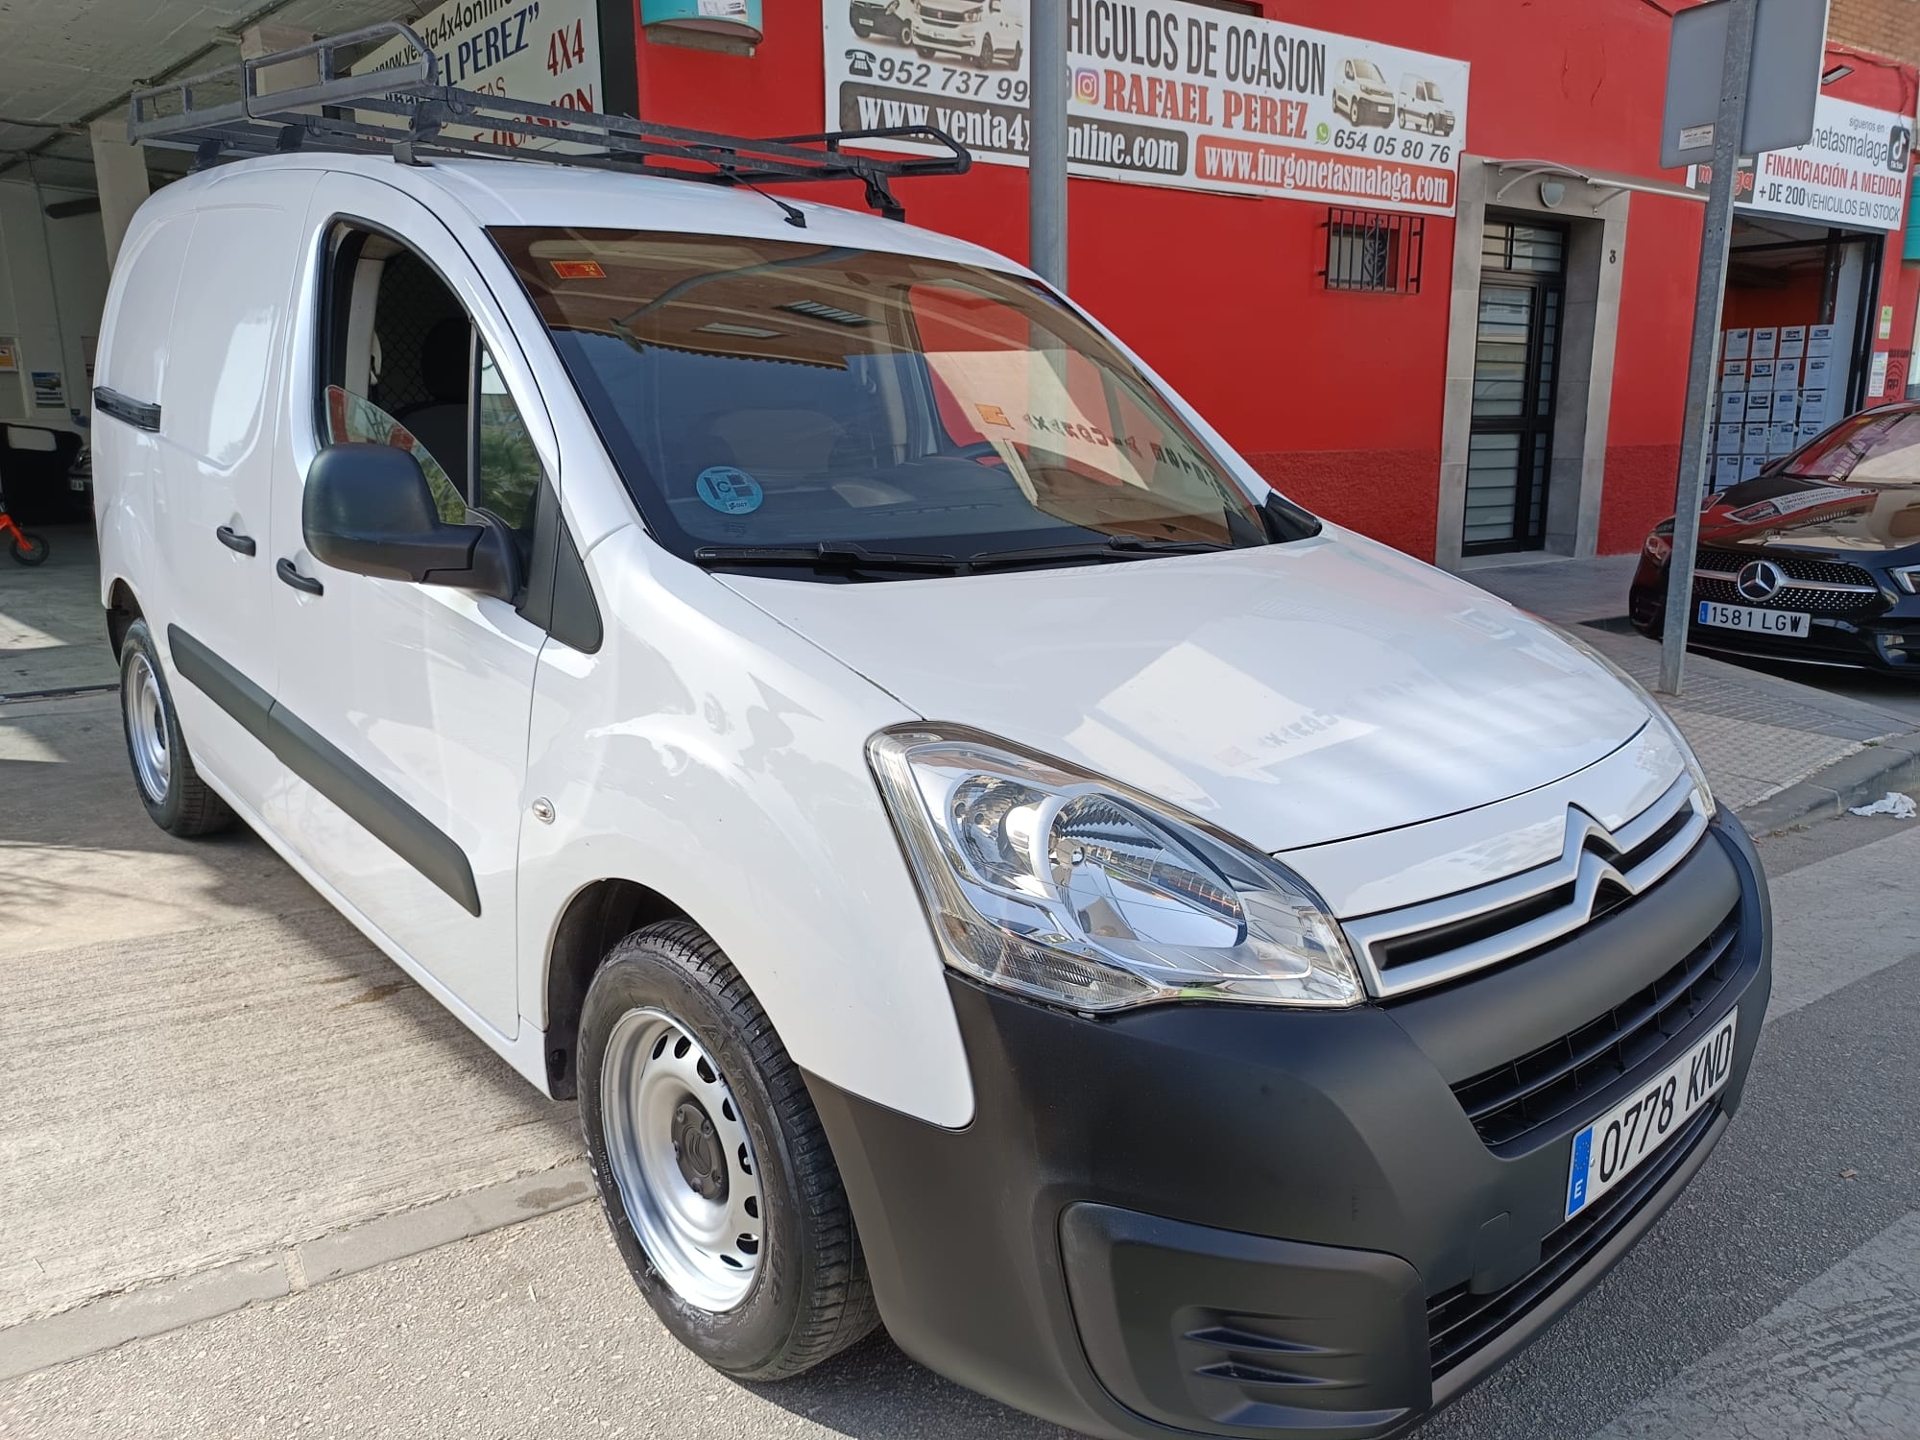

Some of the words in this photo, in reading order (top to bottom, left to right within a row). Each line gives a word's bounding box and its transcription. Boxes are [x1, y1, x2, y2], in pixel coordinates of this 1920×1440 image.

[547, 18, 584, 76] 4X4
[1187, 18, 1218, 78] DE
[1226, 26, 1325, 96] OCASION
[878, 57, 931, 88] 952
[940, 68, 989, 97] 737
[1104, 69, 1213, 127] RAFAEL
[1222, 89, 1309, 139] PEREZ
[1334, 129, 1368, 151] 654
[1373, 135, 1396, 155] 05
[1402, 141, 1424, 159] 80
[1429, 144, 1451, 163] 76
[1204, 146, 1448, 203] www.furgonetasmalaga.com
[1765, 153, 1848, 189] FINANCIACIÓN
[1850, 170, 1858, 191] A
[1861, 172, 1902, 199] MEDIDA
[1759, 186, 1767, 198] +
[1768, 183, 1783, 202] DE
[1785, 185, 1806, 206] 200
[1807, 192, 1857, 216] VEHICULOS
[1860, 201, 1872, 217] EN
[1873, 205, 1901, 222] STOCK
[1712, 606, 1753, 626] 1581
[1761, 612, 1801, 633] LGW
[1599, 1075, 1676, 1183] 0778
[1686, 1023, 1732, 1112] KND
[1573, 1179, 1583, 1199] E
